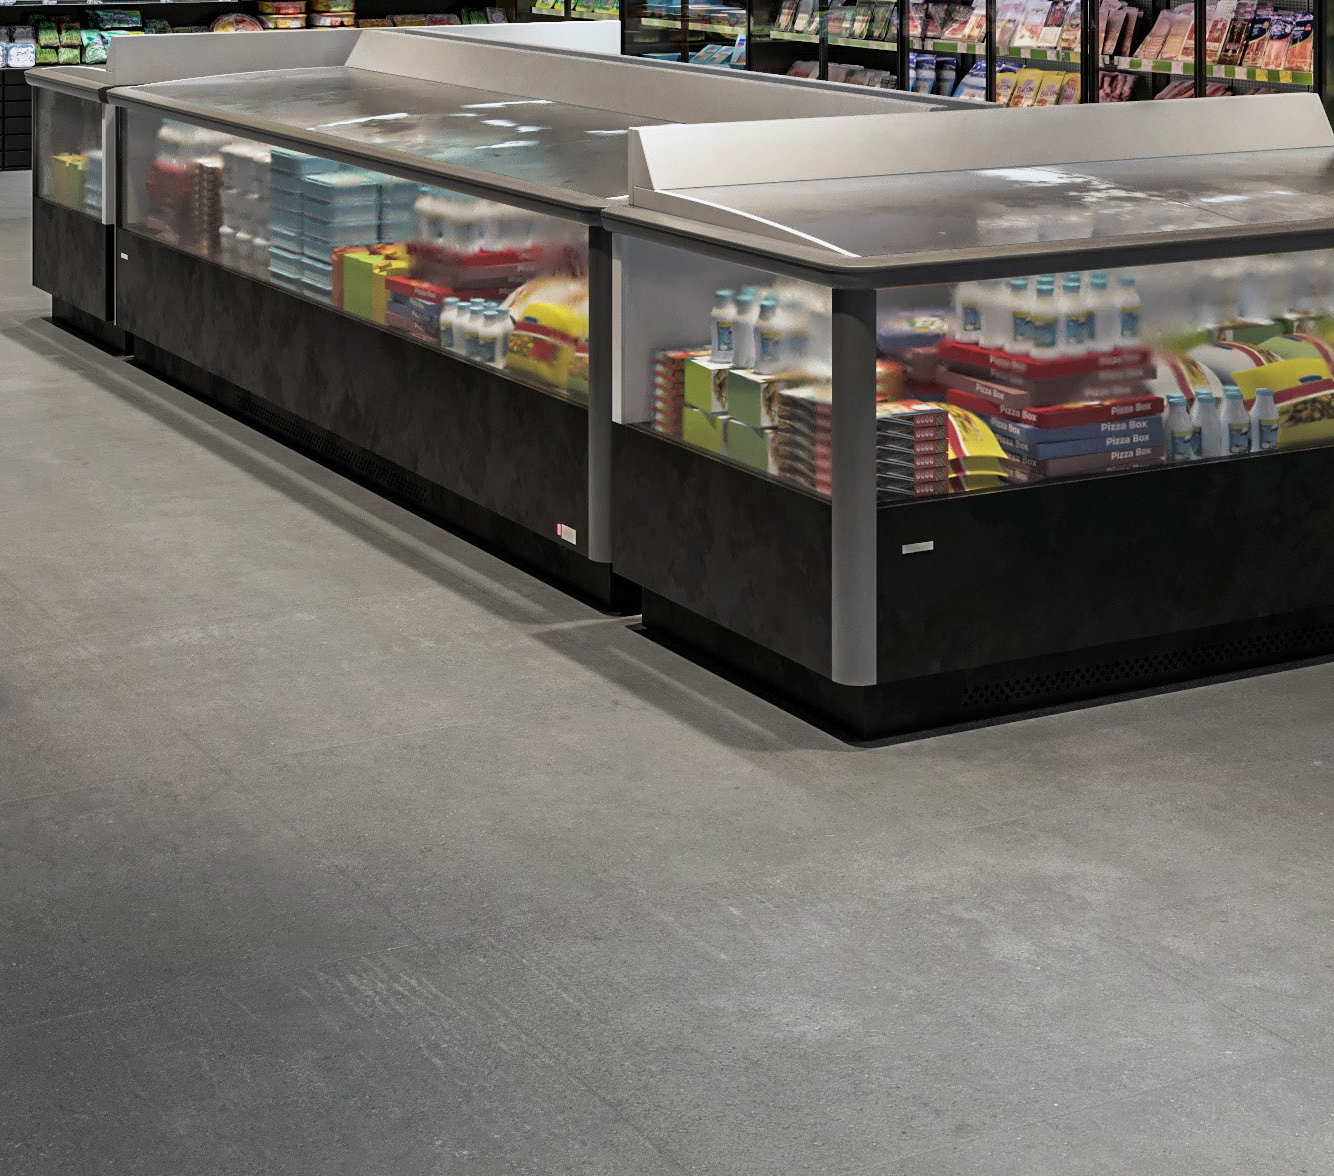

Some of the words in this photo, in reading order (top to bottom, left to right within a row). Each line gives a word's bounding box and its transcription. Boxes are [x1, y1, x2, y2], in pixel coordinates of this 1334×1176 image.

[993, 390, 1004, 401] Box
[1000, 405, 1020, 418] Pizza
[1022, 410, 1037, 421] Box
[1135, 402, 1152, 412] Box
[1008, 424, 1020, 435] Box
[1101, 422, 1127, 431] Pizza
[1129, 419, 1148, 429] Box
[1106, 436, 1131, 446] Pizza
[1133, 434, 1150, 443] Box
[1111, 450, 1134, 460] Pizza
[1136, 447, 1152, 457] Box
